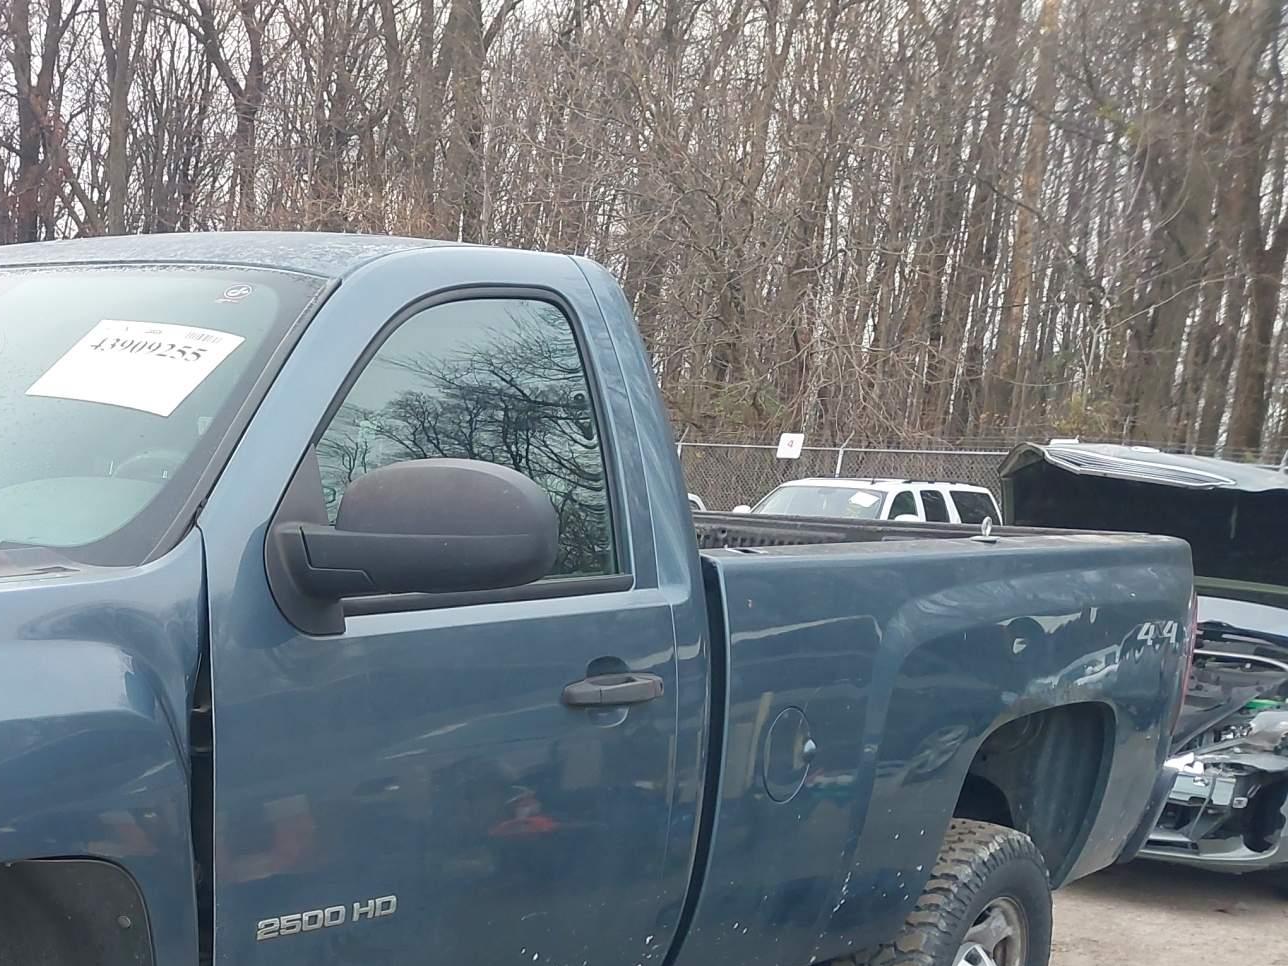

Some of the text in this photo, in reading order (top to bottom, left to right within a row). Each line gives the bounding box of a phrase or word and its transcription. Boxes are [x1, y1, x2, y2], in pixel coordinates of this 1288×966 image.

[91, 337, 208, 362] 43909255
[257, 894, 398, 941] 2500 HD
